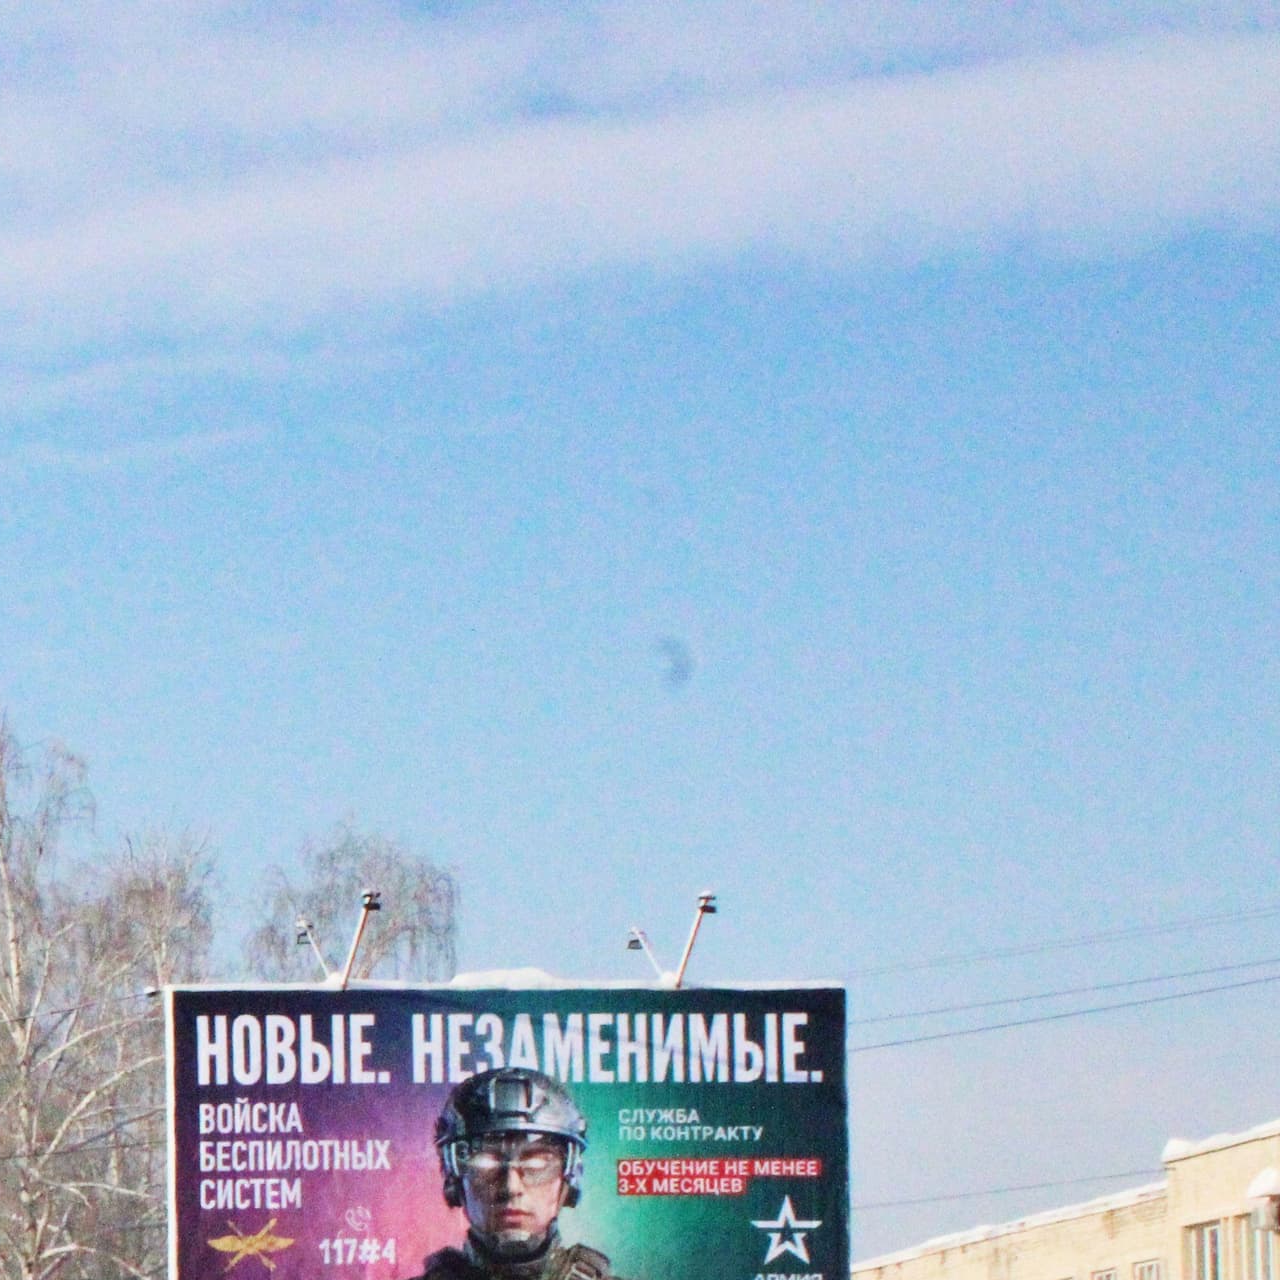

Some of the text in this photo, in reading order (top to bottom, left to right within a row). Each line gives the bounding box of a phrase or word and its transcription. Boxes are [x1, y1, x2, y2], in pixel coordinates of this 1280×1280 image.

[196, 1012, 824, 1085] НОВЫЕ. НЕЗАМЕНИМЫЕ.
[199, 1097, 303, 1134] ВОЙСКА
[618, 1109, 700, 1124] СЛУЖБА
[619, 1126, 763, 1141] ПО КОНТРАКТУ
[199, 1139, 391, 1172] БЕСПИЛОТНЫХ
[618, 1160, 817, 1176] ОБУЧЕНИЕ НЕ МЕНЕЕ
[200, 1178, 303, 1210] СИСТЕМ
[653, 1178, 743, 1195] МЕСЯЦЕВ
[319, 1238, 396, 1264] 117#4
